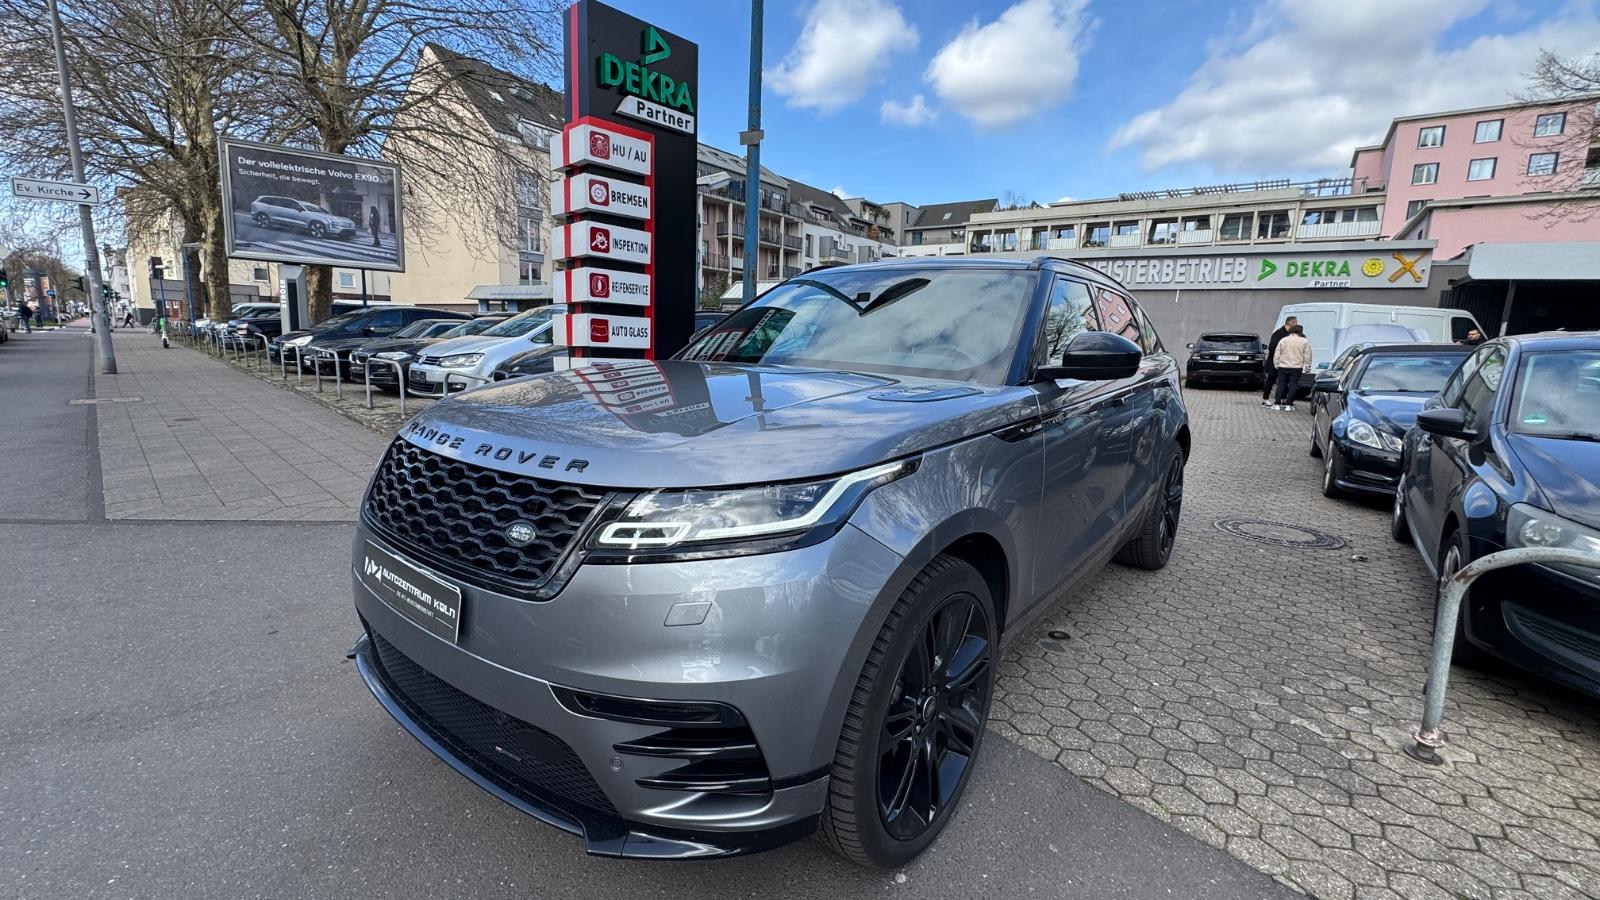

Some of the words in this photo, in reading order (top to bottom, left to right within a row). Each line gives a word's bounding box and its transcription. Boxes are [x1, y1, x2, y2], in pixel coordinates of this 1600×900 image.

[601, 52, 694, 113] DEKRA
[637, 100, 691, 130] Partner
[612, 143, 626, 157] HU
[634, 150, 647, 163] AU
[238, 156, 256, 166] Der
[258, 160, 326, 176] vollelektrische
[328, 169, 353, 179] Volvo
[354, 173, 379, 183] EX90
[238, 168, 278, 181] Sicherheit,
[292, 176, 321, 185] bewegt.
[16, 183, 33, 193] Ev.
[37, 185, 74, 197] Kirche
[611, 191, 648, 208] BREMSEN
[612, 237, 649, 254] INSPEKTION
[1286, 260, 1351, 278] DEKRA
[612, 281, 648, 296] REIFENSERVICE
[1314, 280, 1349, 288] Partner
[611, 326, 628, 337] AUTO
[629, 327, 648, 338] GLASS
[407, 422, 465, 449] RANGE
[474, 443, 590, 473] ROVER
[512, 524, 528, 534] LAND
[382, 568, 432, 605] AUTOZENTRUM
